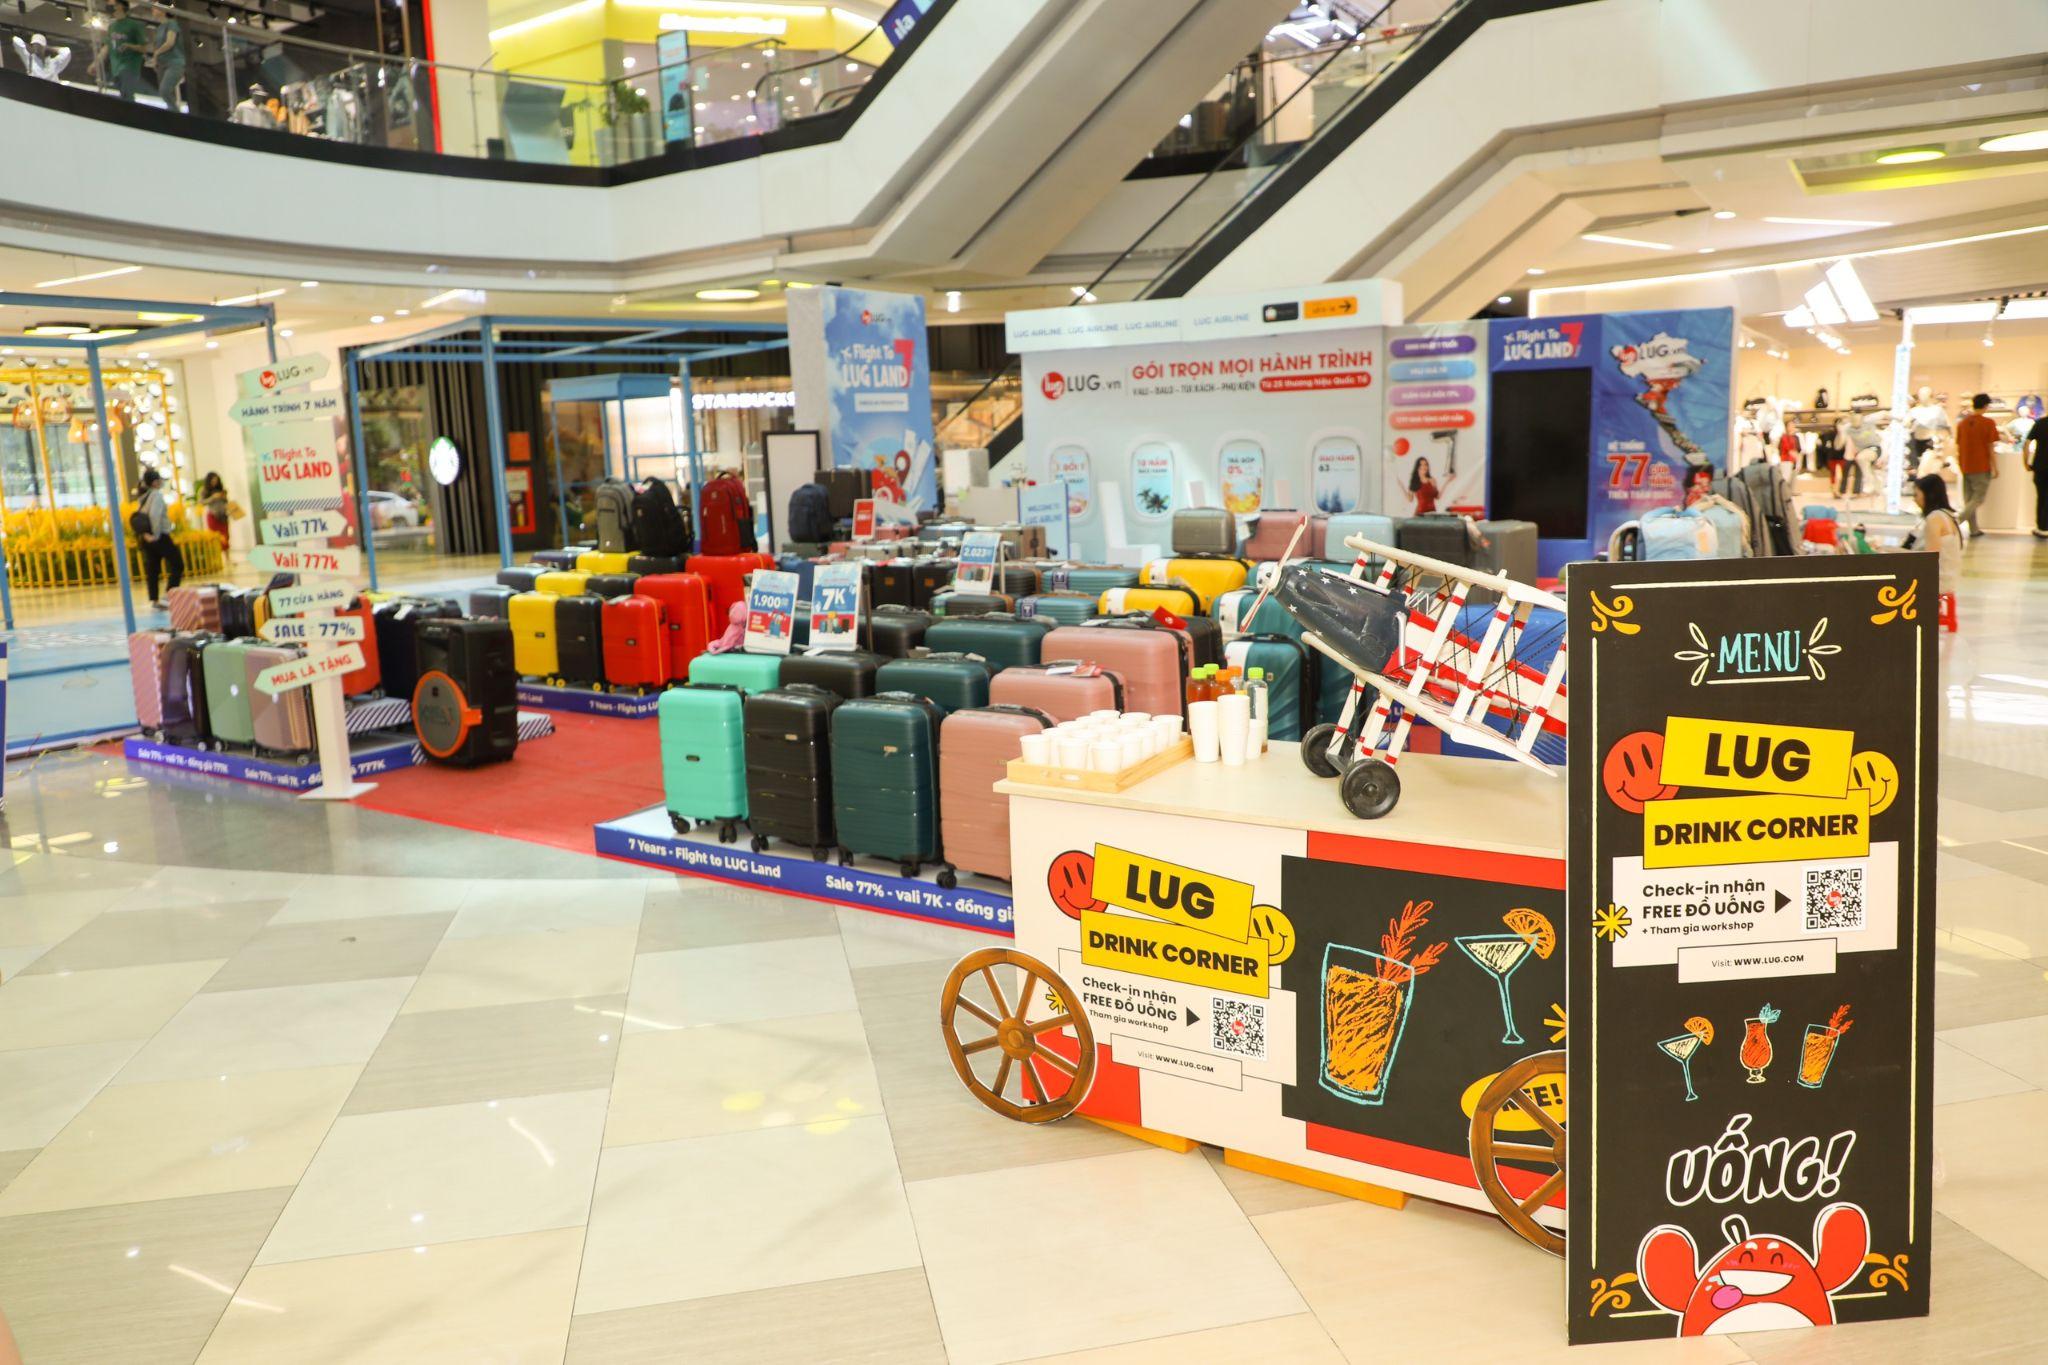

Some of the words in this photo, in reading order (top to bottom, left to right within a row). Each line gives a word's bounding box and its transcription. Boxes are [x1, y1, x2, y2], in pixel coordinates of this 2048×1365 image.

[1517, 328, 1547, 343] Flight
[1549, 328, 1560, 340] To
[853, 343, 882, 363] Flight
[883, 345, 895, 360] To
[1504, 344, 1532, 361] LUG
[1535, 341, 1574, 359] LAND
[1132, 361, 1164, 380] GÓI
[1168, 360, 1214, 380] TRỌN
[1219, 358, 1253, 378] MỌI
[1260, 352, 1312, 372] HÀNH
[1318, 348, 1372, 368] TRÌNH
[842, 364, 871, 388] LUG
[872, 364, 909, 388] LAND
[273, 448, 302, 461] Flight
[304, 447, 316, 458] To
[263, 463, 291, 482] LUG
[294, 461, 333, 480] LAND
[1607, 452, 1652, 487] 77
[272, 522, 299, 538] Vali
[302, 518, 328, 534] 77k
[272, 552, 299, 568] Vali
[303, 554, 339, 570] 777k
[279, 597, 292, 608] 77
[822, 588, 846, 611] 7K
[274, 624, 305, 638] SALE
[319, 623, 355, 636] 77%
[1717, 630, 1801, 674] MENU
[271, 672, 297, 686] MUA
[300, 664, 316, 678] LÀ
[320, 654, 352, 673] TẶNG
[1704, 732, 1811, 783] LUG
[1654, 820, 1742, 846] DRINK
[1747, 814, 1859, 841] CORNER
[628, 838, 635, 850] 7
[637, 839, 667, 856] Years
[675, 846, 708, 865] Flight
[710, 854, 722, 867] to
[724, 856, 748, 872] LUG
[751, 860, 781, 878] Land
[826, 875, 854, 892] Sale
[856, 880, 884, 898] 77%
[896, 890, 920, 905] vali
[923, 892, 944, 908] 7K
[955, 898, 994, 920] đồng
[997, 908, 1015, 924] gi
[1126, 864, 1215, 920] LUG
[1642, 881, 1720, 898] Check-in
[1722, 878, 1766, 896] nhận
[1642, 904, 1682, 920] FREE
[1685, 896, 1711, 918] ĐỒ
[1715, 895, 1766, 916] UỐNG
[1650, 926, 1682, 936] Tham
[1682, 924, 1700, 936] gia
[1701, 920, 1754, 934] workshop
[1089, 930, 1158, 960] DRINK
[1162, 948, 1259, 978] CORNER
[1712, 958, 1733, 968] Visit:
[1734, 954, 1805, 966] WWW.LUG.COM
[1082, 976, 1140, 997] Check-in
[1143, 988, 1177, 1005] nhận
[1083, 992, 1112, 1009] FREE
[1114, 994, 1134, 1012] ĐỒ
[1138, 1000, 1178, 1022] UỐNG
[1089, 1010, 1112, 1022] Tham
[1113, 1014, 1127, 1025] gia
[1128, 1016, 1169, 1033] workshop
[1156, 1054, 1214, 1073] WWW.LUG.COM
[1666, 1113, 1856, 1207] UỐNG!
